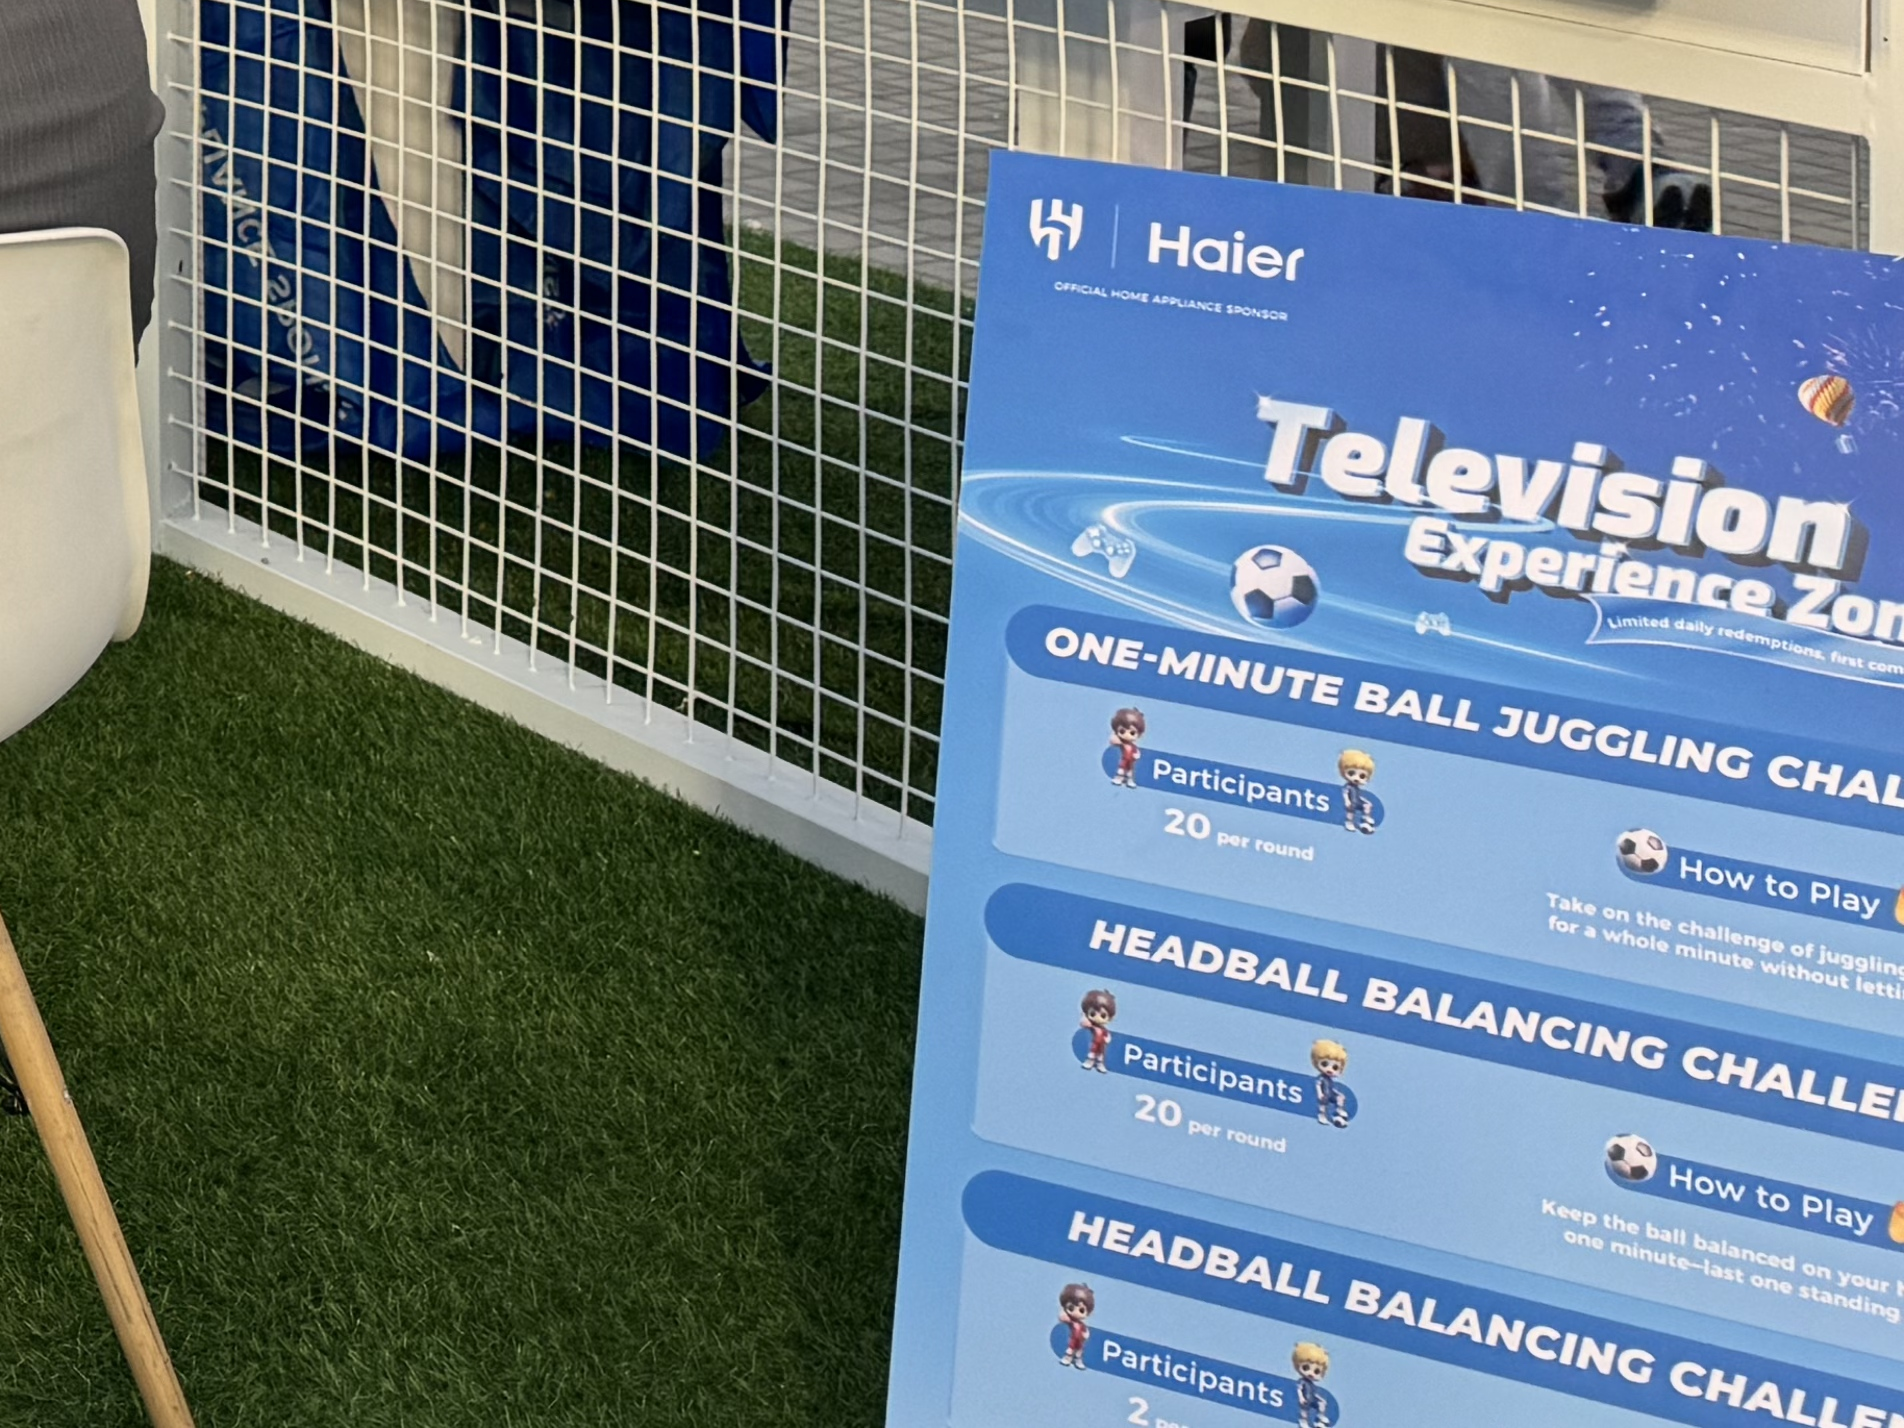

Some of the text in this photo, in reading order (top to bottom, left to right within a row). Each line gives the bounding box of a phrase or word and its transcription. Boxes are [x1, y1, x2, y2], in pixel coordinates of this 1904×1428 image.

[1147, 221, 1305, 282] Haier
[1054, 281, 1288, 321] OFFICIAL HOME APPLIANCE SPONSOR
[1257, 397, 1854, 570] Television
[1404, 516, 1775, 618] Experience
[1607, 616, 1670, 630] Limited
[1675, 618, 1714, 636] daily
[1831, 651, 1863, 668] first
[1044, 626, 1343, 707] ONE-MINUTE
[1353, 681, 1480, 734] BALL
[1490, 705, 1754, 780] JUGGLING
[1152, 758, 1330, 812] Participants
[1163, 807, 1315, 861] 20 per round
[1679, 856, 1880, 920] How to Play
[1547, 892, 1597, 916] Take
[1602, 906, 1629, 923] on
[1636, 912, 1672, 931] the
[1678, 921, 1785, 954] challenge
[1790, 943, 1814, 959] of
[1548, 915, 1904, 1000] for a whole minute without letti
[1088, 919, 1904, 1123] HEADBALL BALANCING CHALLE
[1124, 1043, 1302, 1104] Participants
[1134, 1095, 1287, 1153] 20 per round
[1669, 1164, 1874, 1236] How to Play
[1541, 1198, 1597, 1227] Keep
[1603, 1214, 1639, 1235] the
[1645, 1222, 1686, 1246] ball
[1693, 1233, 1795, 1272] balanced
[1802, 1261, 1831, 1281] on
[1837, 1269, 1889, 1294] your
[1564, 1230, 1604, 1250] one
[1750, 1273, 1793, 1295] one
[1798, 1285, 1901, 1325] standing
[1067, 1210, 1332, 1305] HEADBALL
[1343, 1281, 1654, 1384] BALANCING
[1102, 1339, 1284, 1408] Participants
[1128, 1396, 1149, 1426] 2
